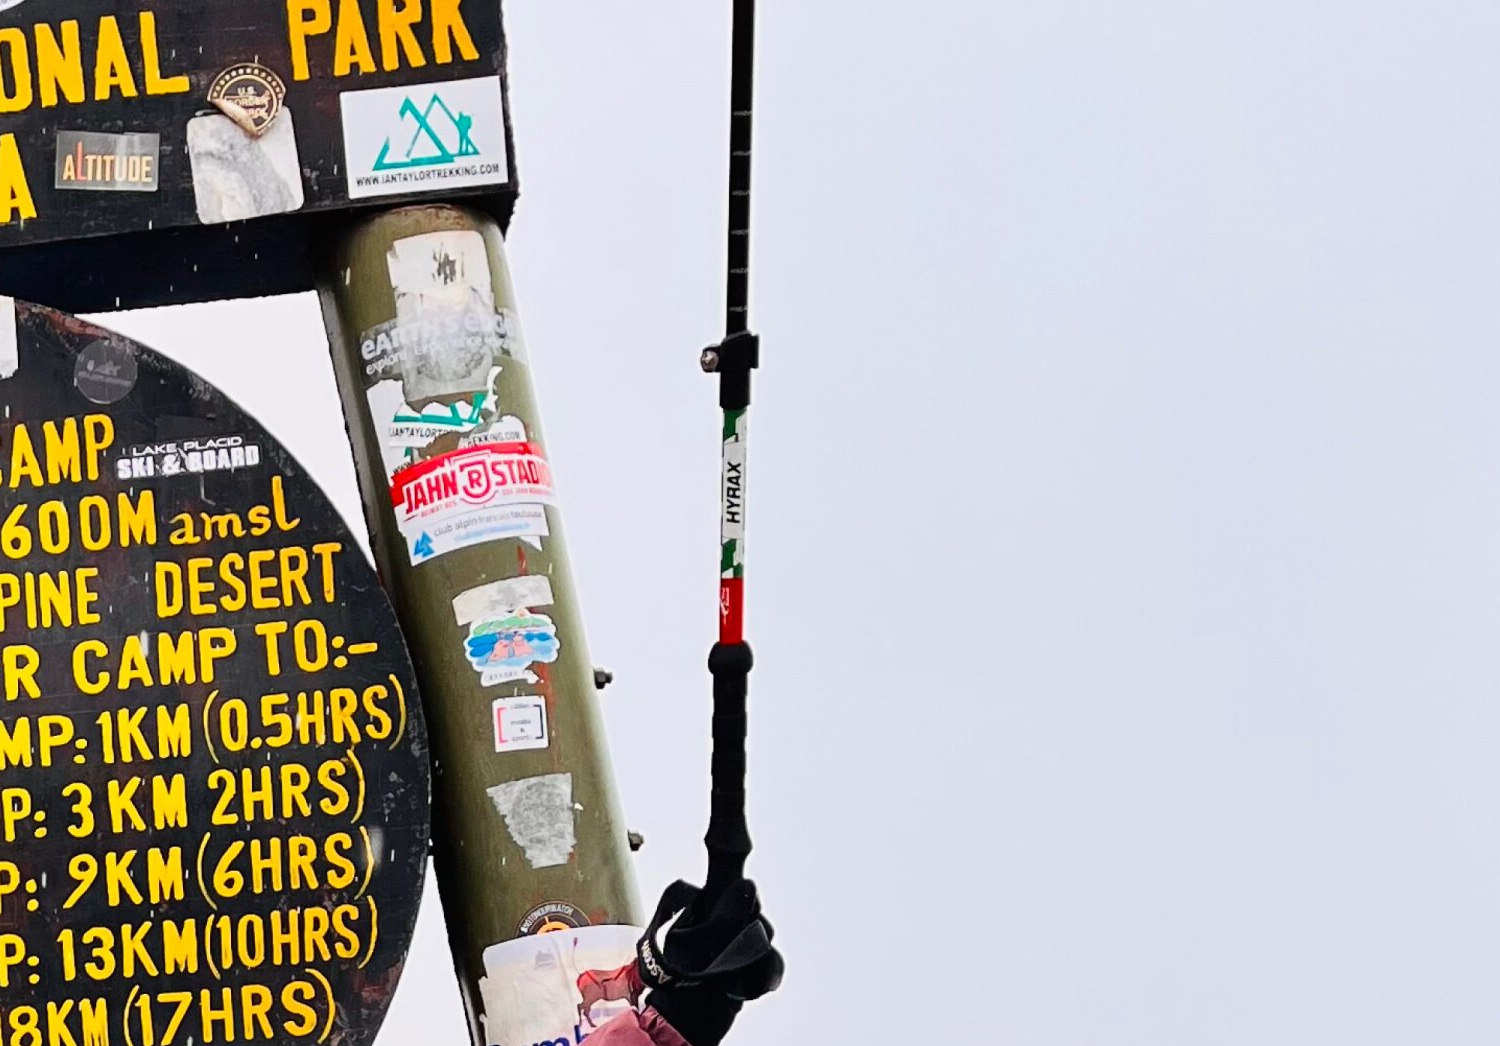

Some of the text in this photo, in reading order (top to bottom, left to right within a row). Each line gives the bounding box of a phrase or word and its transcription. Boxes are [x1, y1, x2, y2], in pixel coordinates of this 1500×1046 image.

[286, 0, 480, 82] PARK
[62, 141, 153, 182] ALTITUDE
[356, 163, 500, 187] WWW.IANTAYLORTREKKING.COM
[116, 457, 155, 480] SKI
[132, 435, 243, 457] LAKE PLACID
[169, 474, 300, 546] amsl
[405, 470, 458, 515] JAHN
[725, 461, 742, 524] HYRAX
[154, 542, 342, 619] DESERT
[72, 627, 237, 695] CAMP
[208, 746, 367, 826] 2HRS)
